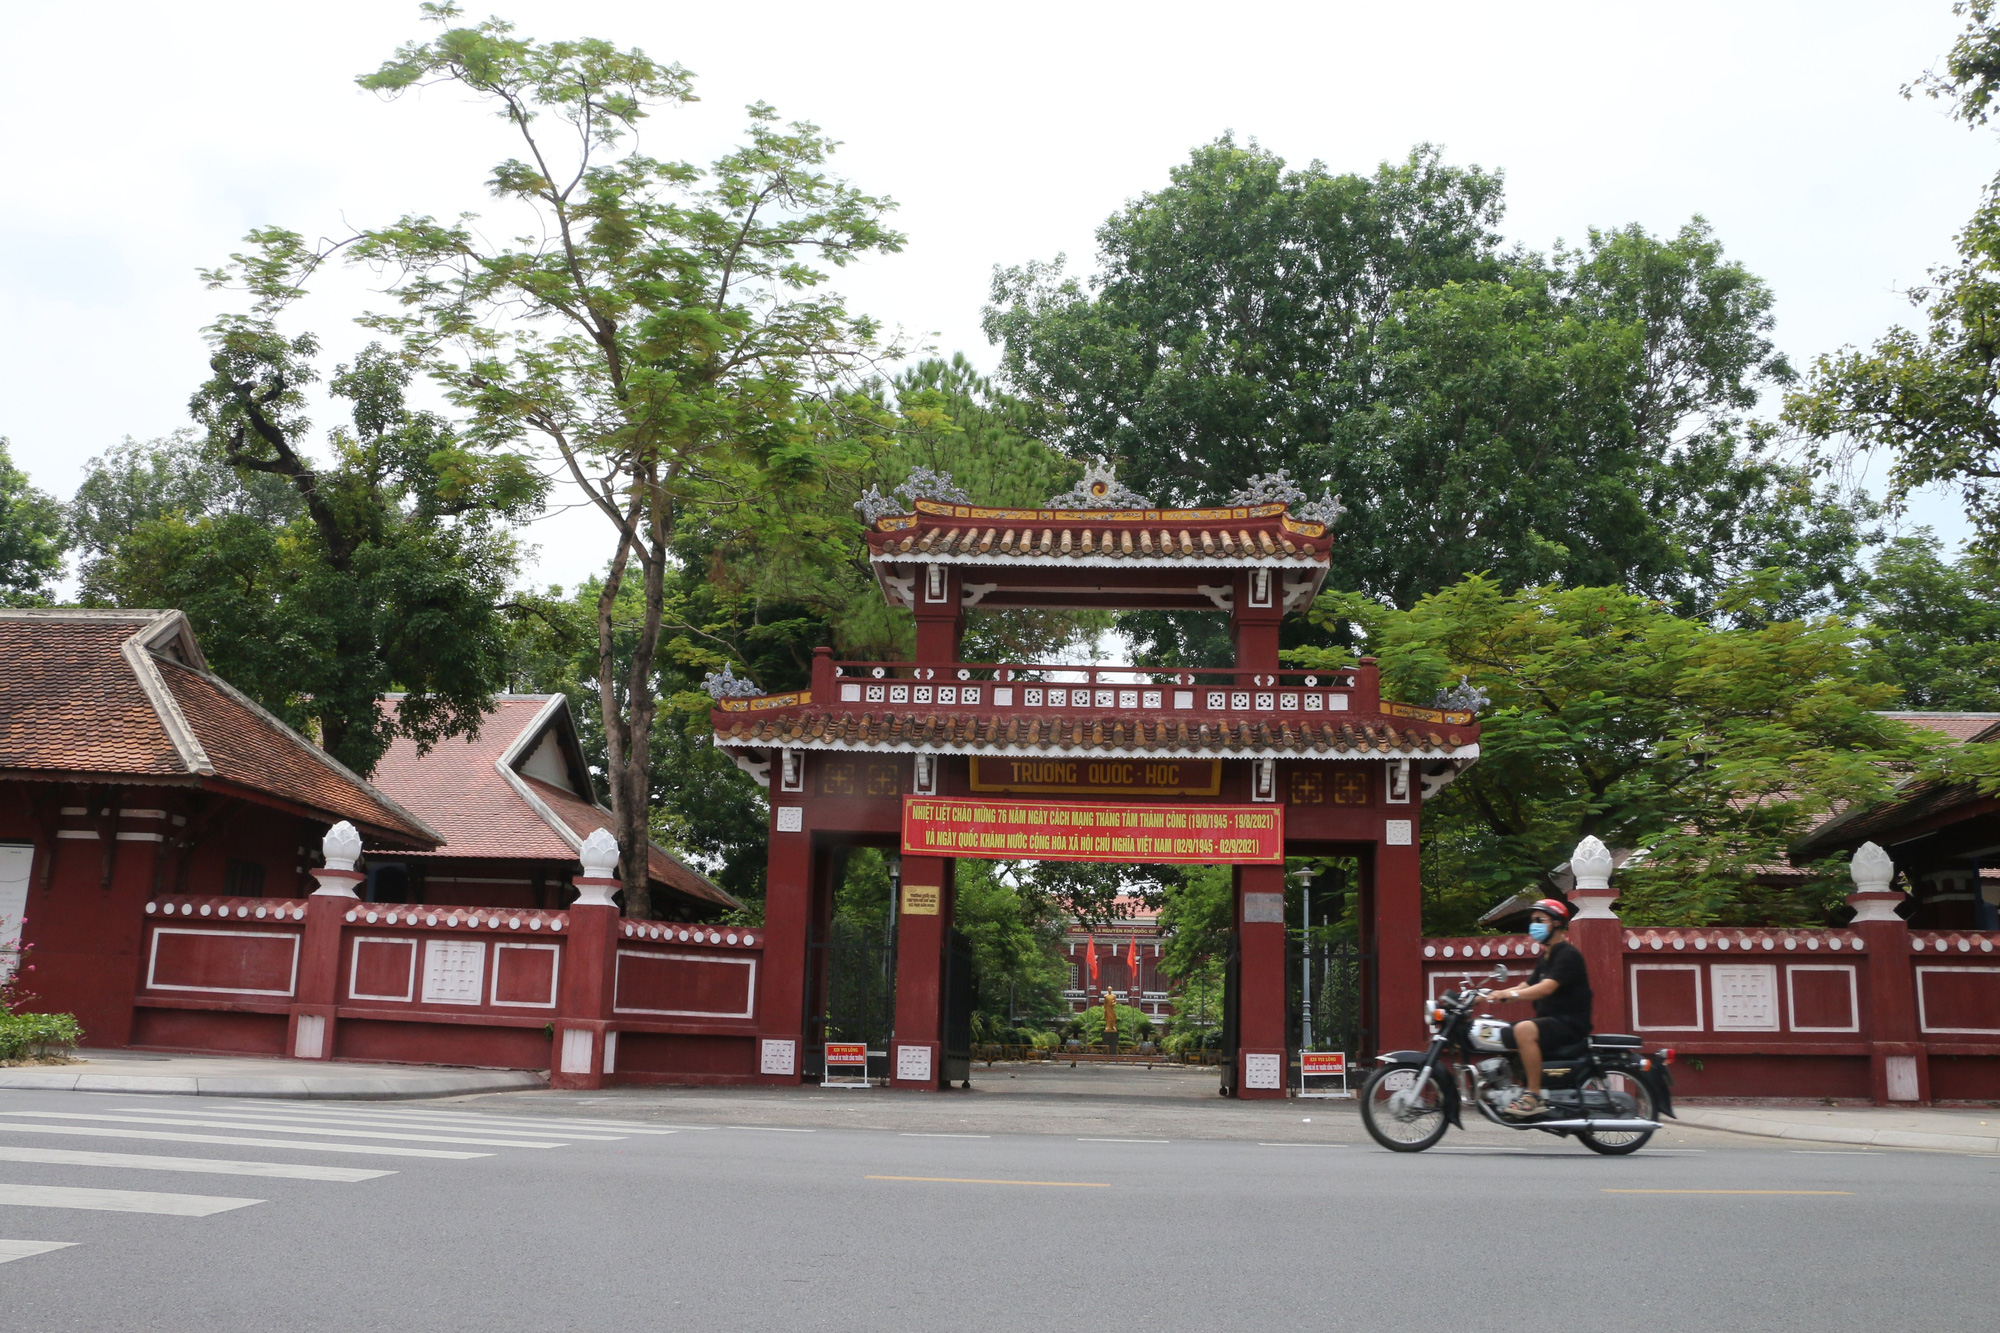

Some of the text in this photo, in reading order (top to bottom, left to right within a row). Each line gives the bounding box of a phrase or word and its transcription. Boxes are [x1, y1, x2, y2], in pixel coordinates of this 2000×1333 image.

[1010, 760, 1077, 784] TRƯỜNG
[1089, 761, 1133, 785] QUỐC
[1145, 764, 1180, 787] HỌC
[912, 803, 934, 824] NHIỆT
[935, 803, 951, 824] LIỆT
[952, 804, 972, 822] CHÀO
[973, 805, 996, 823] MỪNG
[998, 809, 1007, 823] 76
[1008, 807, 1026, 824] NĂM
[1027, 807, 1048, 825] NGÀY
[1049, 808, 1070, 825] CÁCH
[1071, 811, 1094, 829] MẠNG
[1096, 809, 1120, 827] THÁNG
[1122, 809, 1138, 827] TÁM
[1140, 810, 1164, 828] THÀNH
[1166, 811, 1187, 828] CÔNG
[1188, 814, 1228, 830] (19/8/1945
[1235, 814, 1274, 830] 19/8/2021)
[926, 828, 935, 845] VÀ
[937, 828, 957, 846] NGÀY
[959, 827, 979, 848] QUỐC
[980, 830, 1005, 848] KHÁNH
[1007, 831, 1028, 849] NƯỚC
[1029, 832, 1050, 853] CỘNG
[1051, 832, 1067, 850] HÒA
[1068, 833, 1079, 851] XÃ
[1080, 833, 1093, 854] HỘI
[1095, 832, 1110, 851] CHỦ
[1112, 834, 1135, 852] NGHĨA
[1136, 834, 1153, 856] VIỆT
[1154, 838, 1172, 853] NAM
[1174, 838, 1213, 854] (02/9/1945
[1220, 839, 1259, 855] 02/9/2021)
